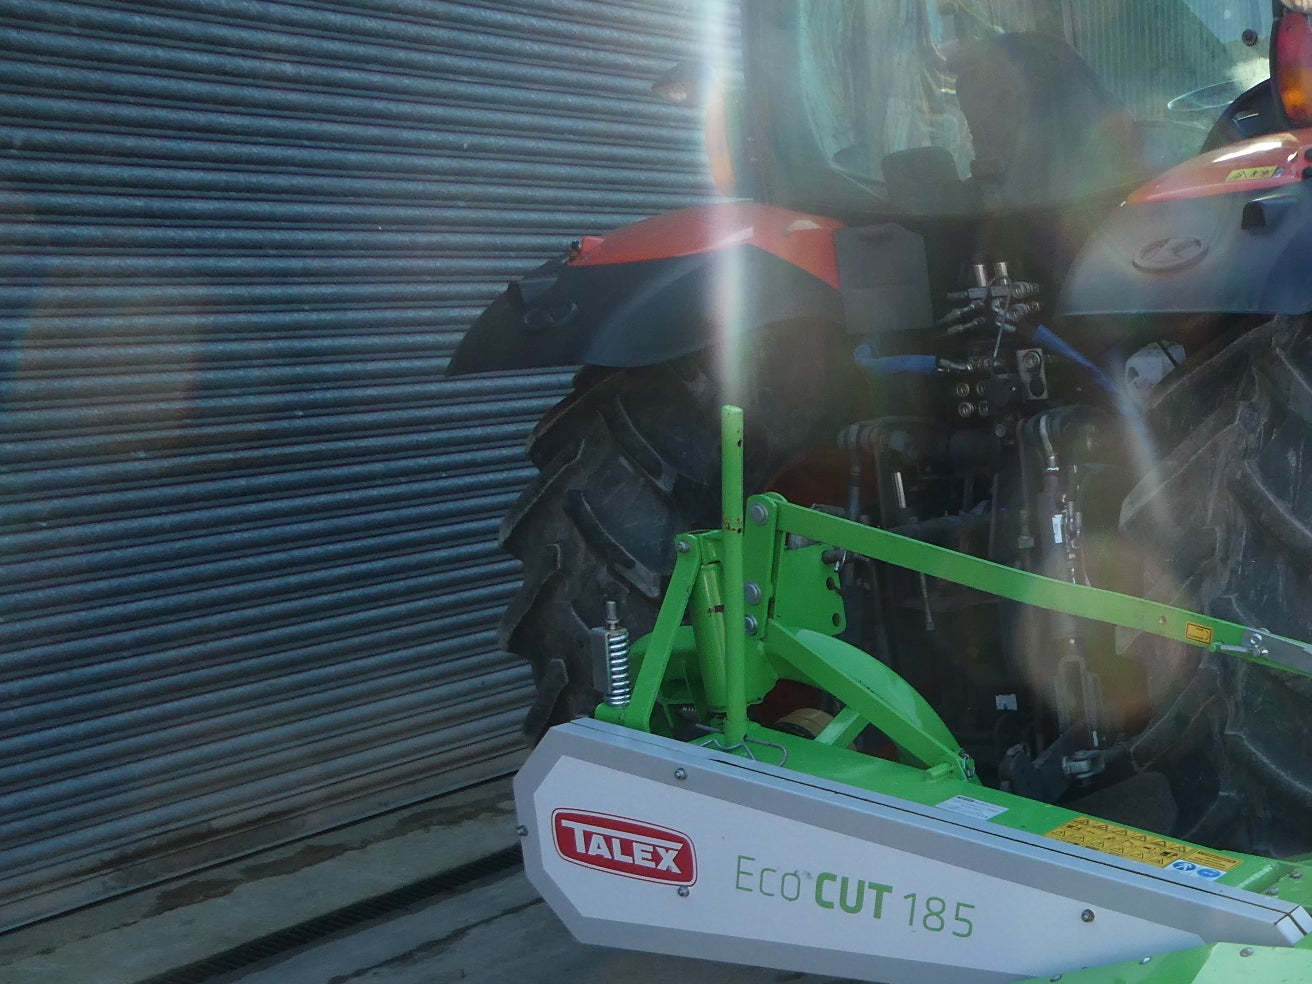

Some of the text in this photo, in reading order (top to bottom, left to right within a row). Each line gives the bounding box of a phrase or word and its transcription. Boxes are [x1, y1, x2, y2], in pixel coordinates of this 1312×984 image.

[561, 819, 683, 874] TALEX
[815, 871, 893, 920] CUT
[903, 892, 976, 938] 185
